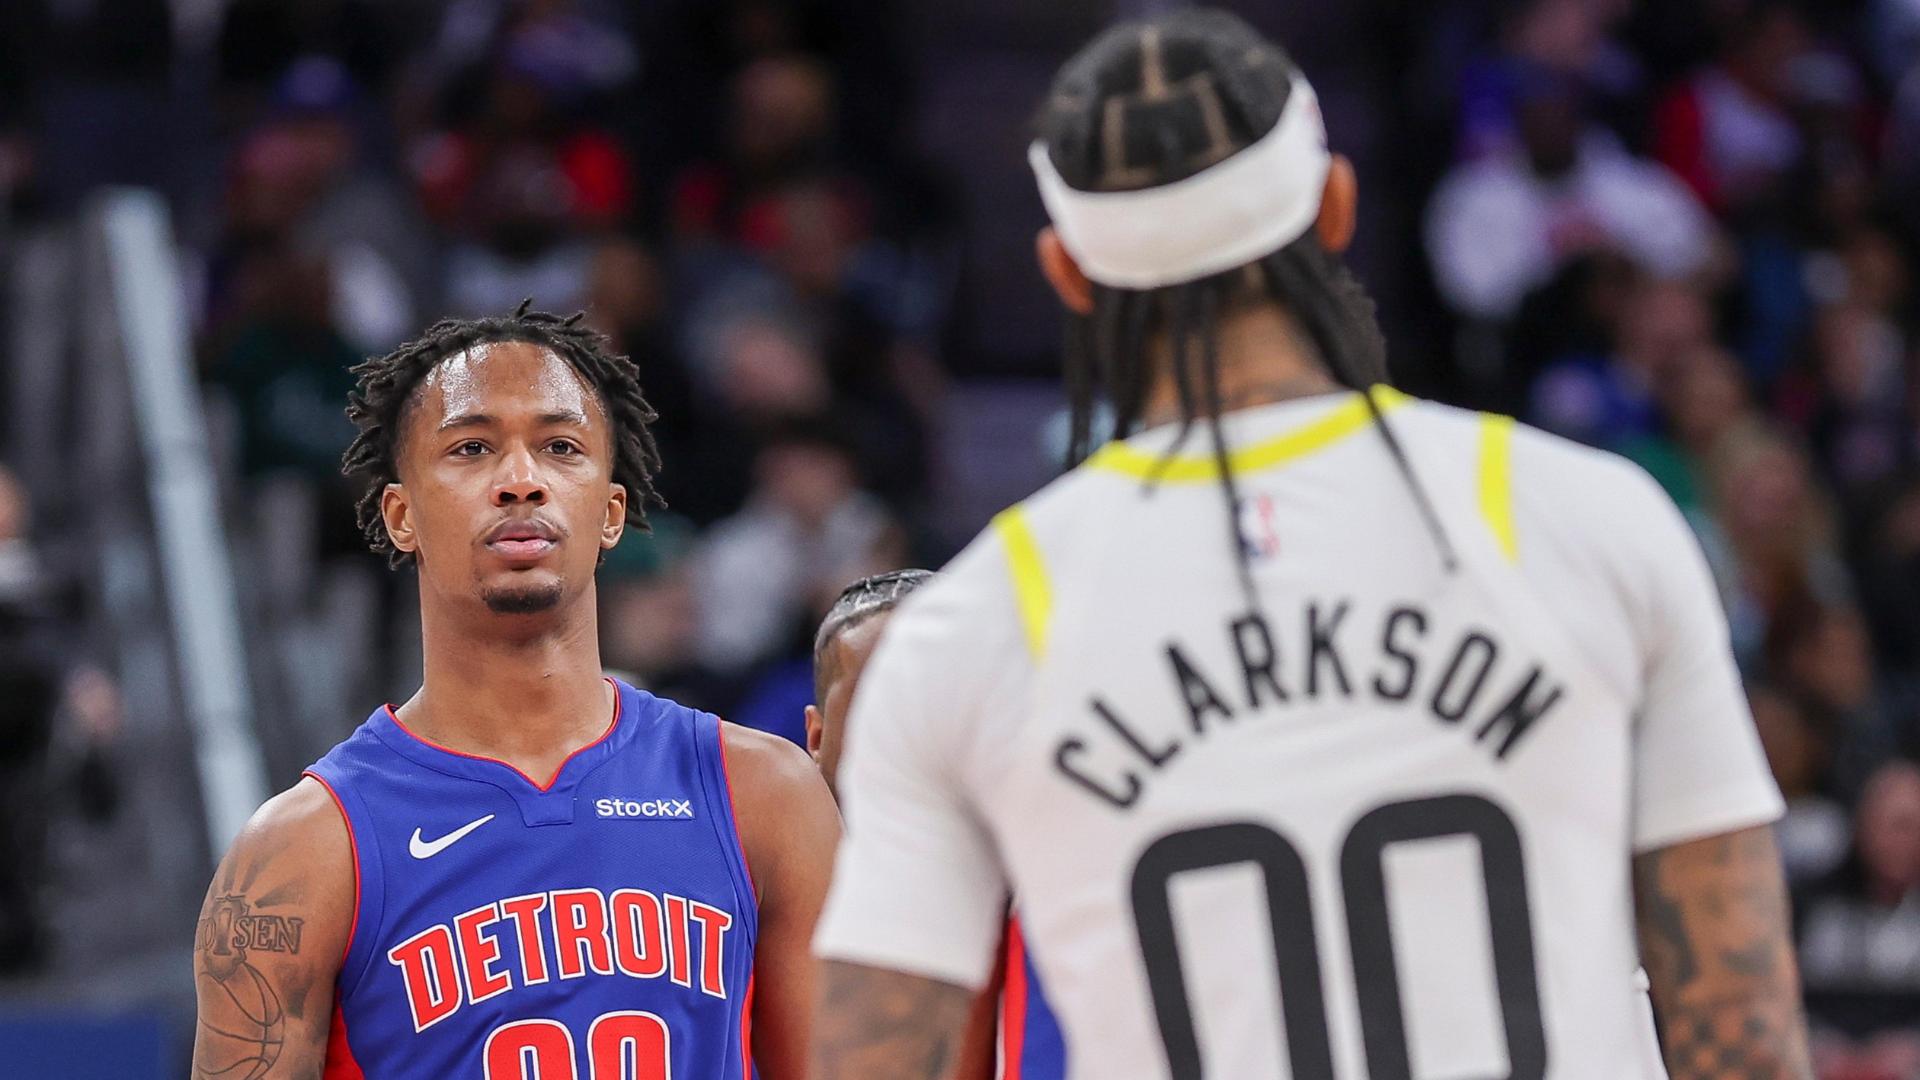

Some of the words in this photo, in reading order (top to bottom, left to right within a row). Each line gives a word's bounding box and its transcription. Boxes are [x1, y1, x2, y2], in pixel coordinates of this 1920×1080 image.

[1052, 601, 1566, 812] CLARKSON
[595, 798, 694, 818] StockX
[387, 887, 732, 1033] DETROIT
[1130, 793, 1548, 1080] 00
